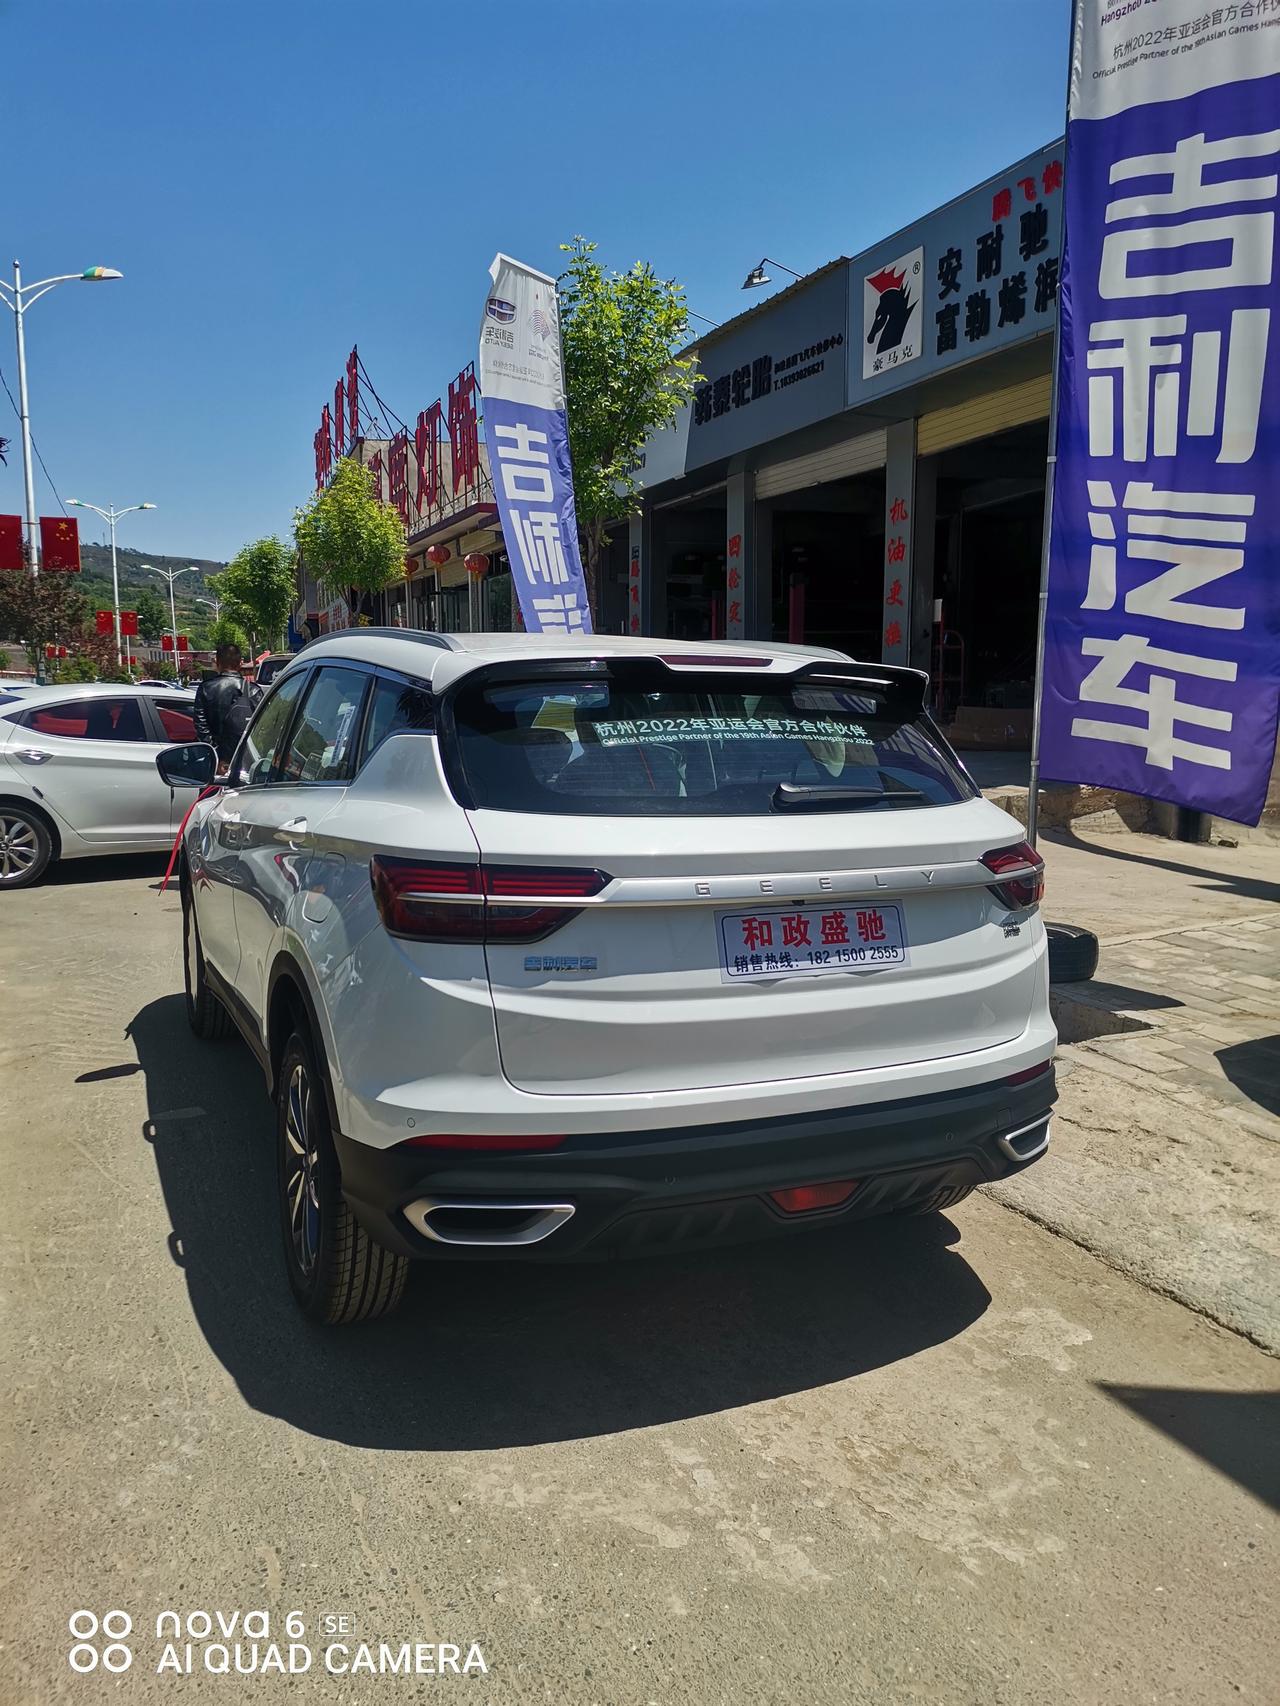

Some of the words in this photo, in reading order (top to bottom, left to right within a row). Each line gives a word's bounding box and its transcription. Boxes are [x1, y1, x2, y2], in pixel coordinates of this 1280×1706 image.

[1092, 65, 1116, 79] Official
[1140, 49, 1169, 62] Partner
[1171, 46, 1180, 55] of
[1181, 43, 1193, 53] the
[1228, 23, 1259, 36] Games
[1071, 129, 1280, 771] 吉利汽车
[596, 718, 868, 738] 杭州2022年亚运会官方合作伙伴
[602, 737, 640, 746] Official
[640, 733, 678, 743] Prestige
[679, 732, 712, 740] Partner
[714, 731, 724, 739] of
[724, 731, 739, 739] the
[761, 731, 784, 739] Asian
[785, 732, 813, 740] Games
[813, 734, 854, 743] Hangzhou
[695, 871, 936, 896] GEELY
[741, 908, 887, 951] 和政盛驰
[807, 950, 831, 966] 182
[836, 947, 866, 963] 1500
[870, 944, 899, 961] 2555
